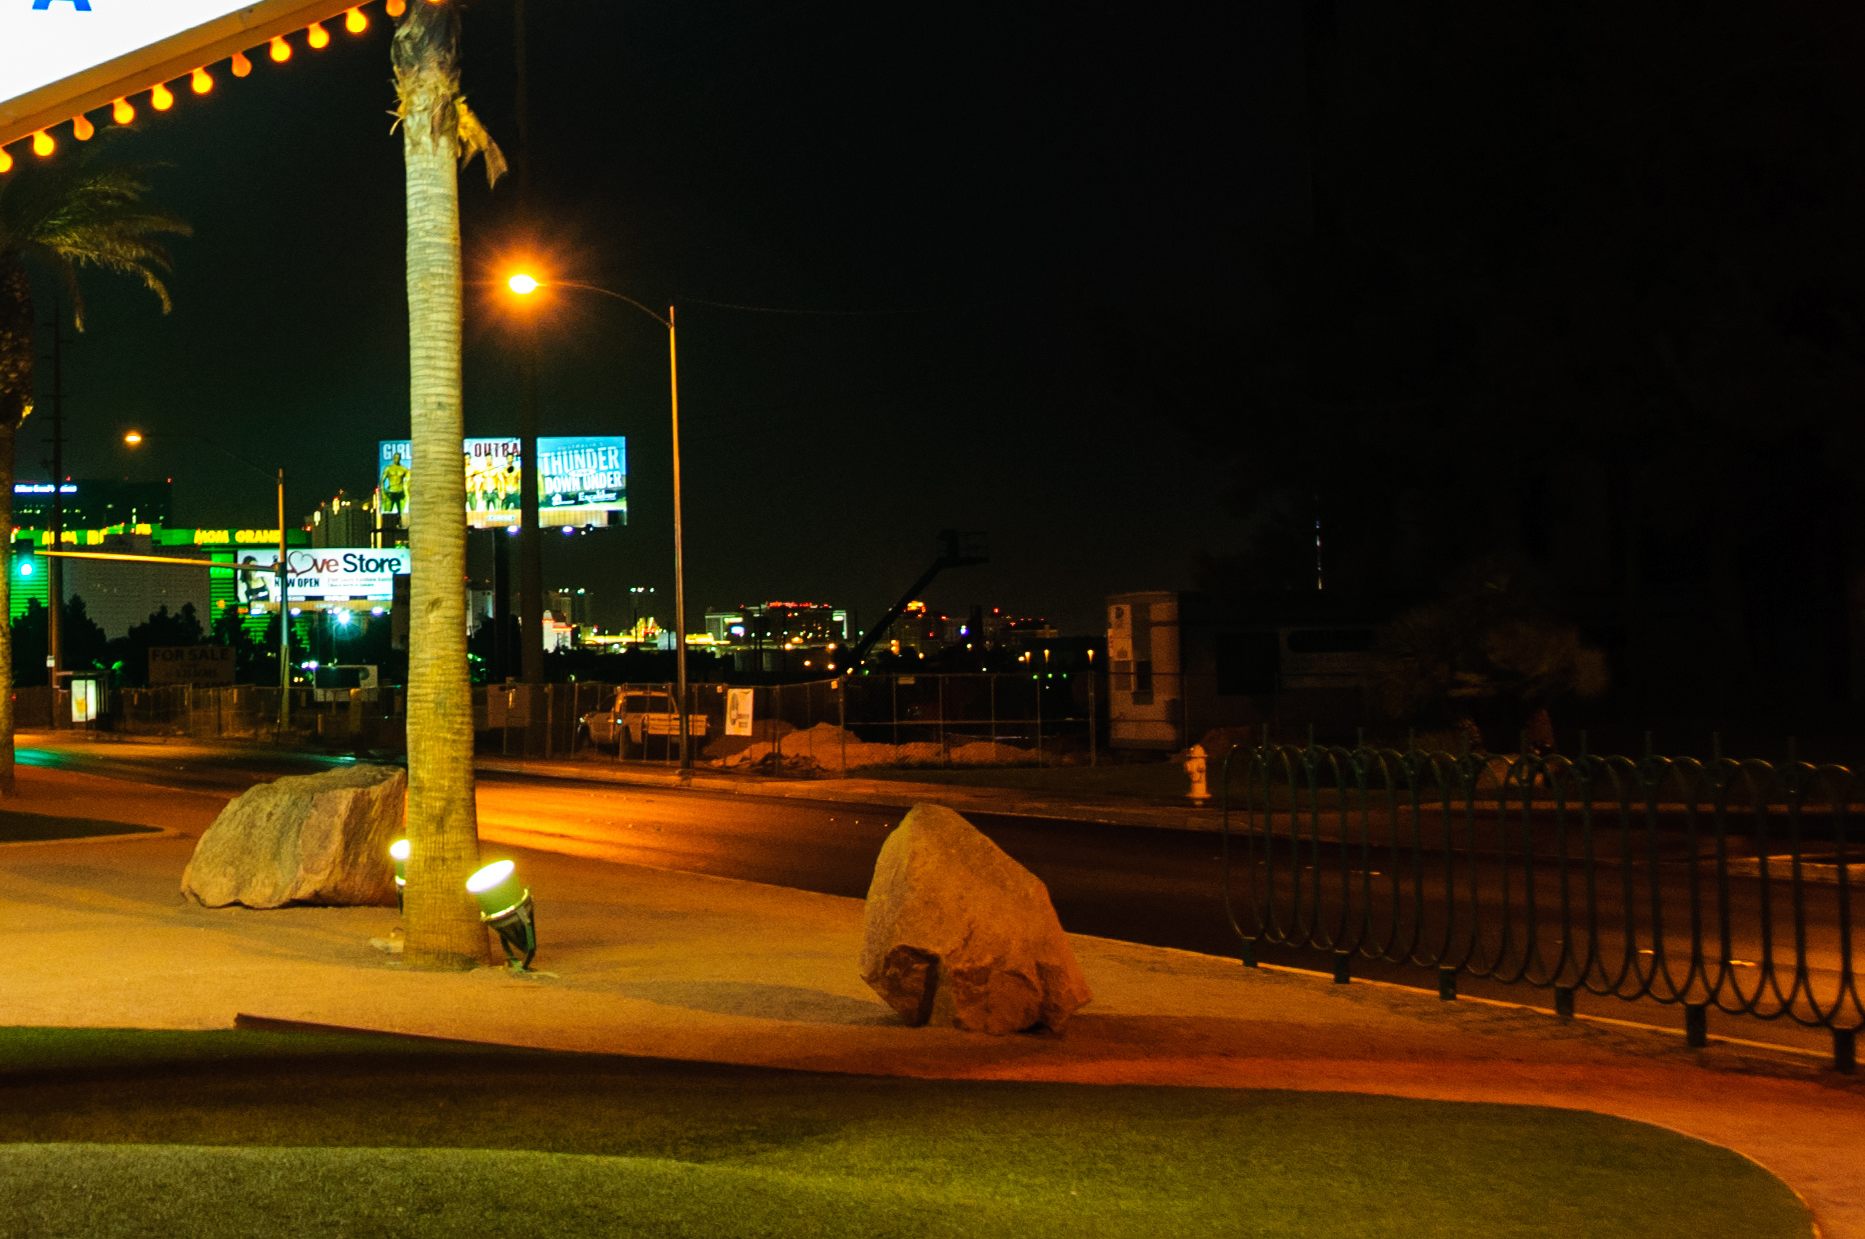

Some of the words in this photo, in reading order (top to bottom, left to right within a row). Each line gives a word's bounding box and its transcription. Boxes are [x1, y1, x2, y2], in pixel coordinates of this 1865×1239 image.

[474, 442, 521, 457] OUTBA
[541, 447, 621, 477] THUNDER
[545, 476, 582, 495] DOWN
[583, 471, 624, 491] UNDER
[342, 552, 402, 574] Store
[274, 577, 295, 588] NW
[297, 577, 320, 588] OPEN
[152, 649, 185, 662] FOR
[189, 648, 230, 661] SALE
